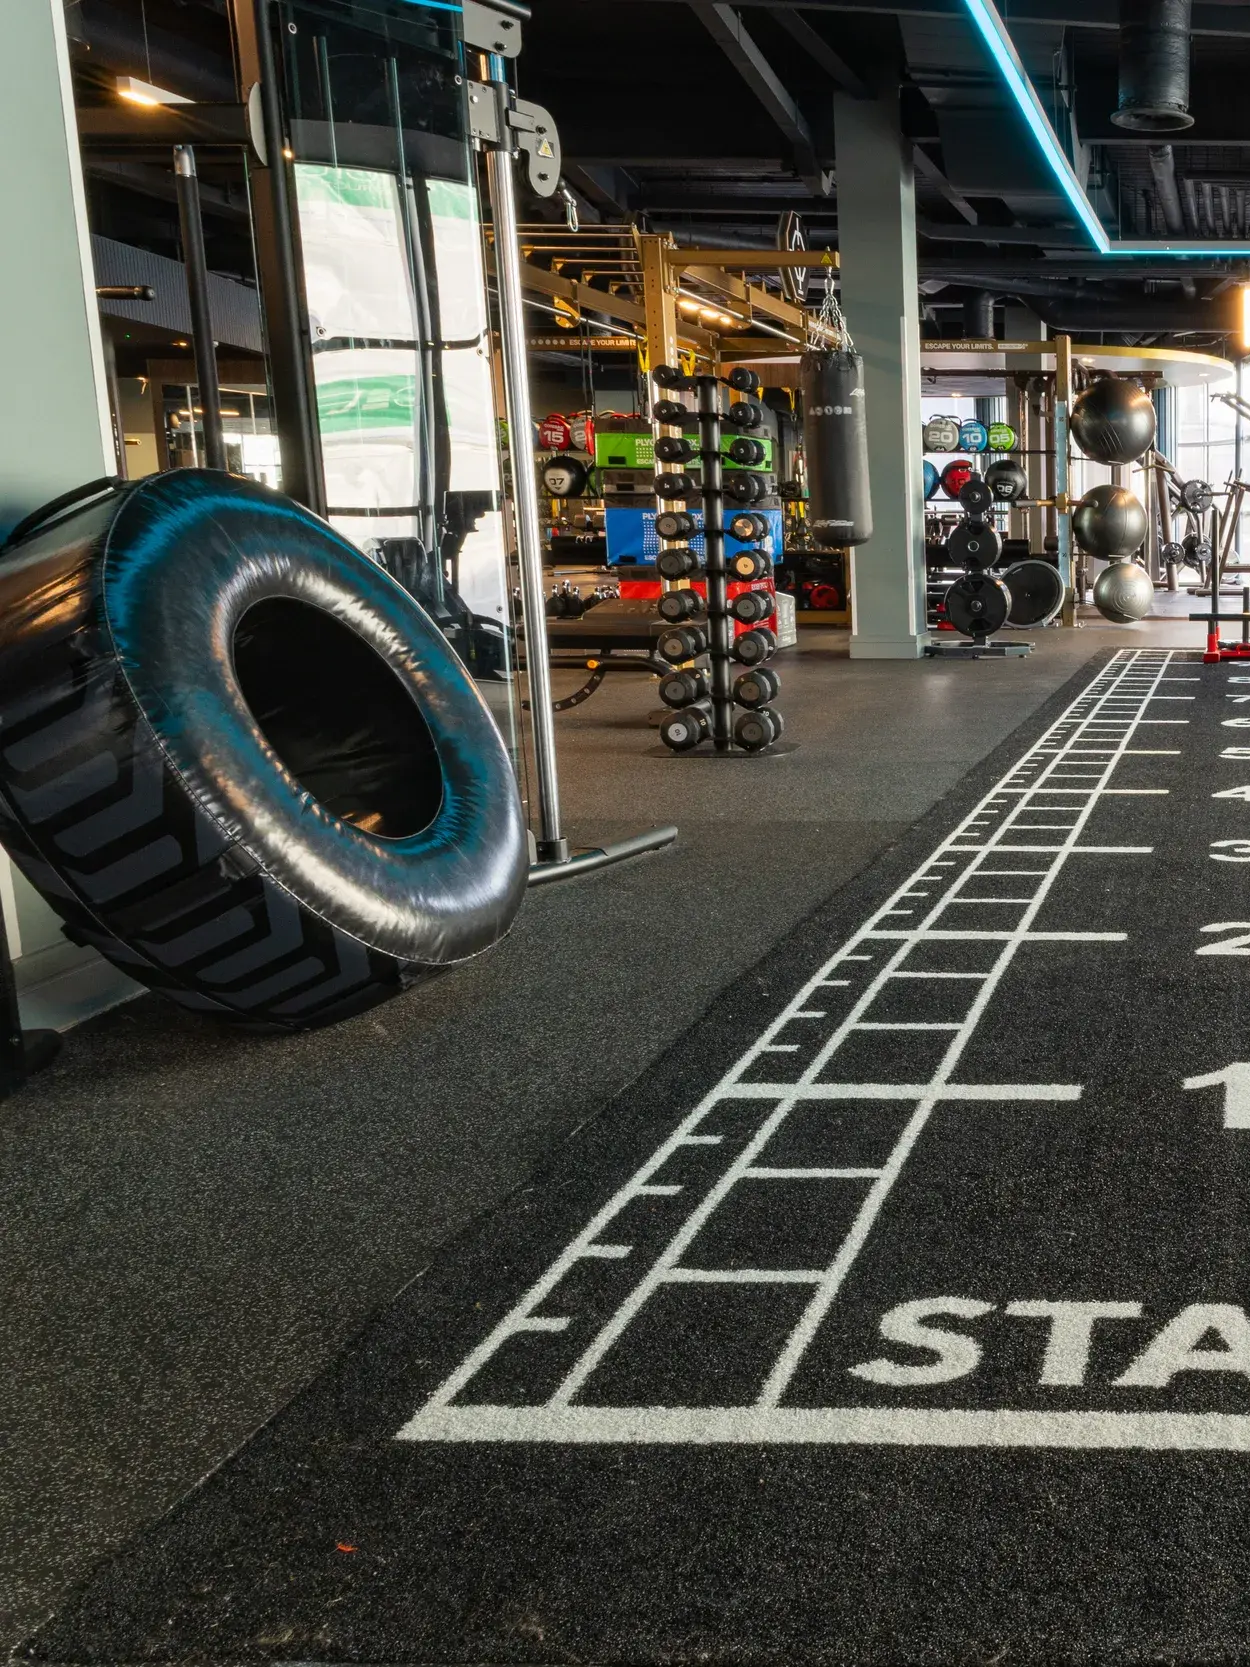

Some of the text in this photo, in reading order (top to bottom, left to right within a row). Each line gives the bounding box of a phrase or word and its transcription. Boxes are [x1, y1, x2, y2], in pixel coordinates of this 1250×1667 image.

[543, 430, 564, 444] 15
[928, 431, 954, 443] 20
[962, 433, 982, 443] 10
[989, 433, 1011, 443] 05
